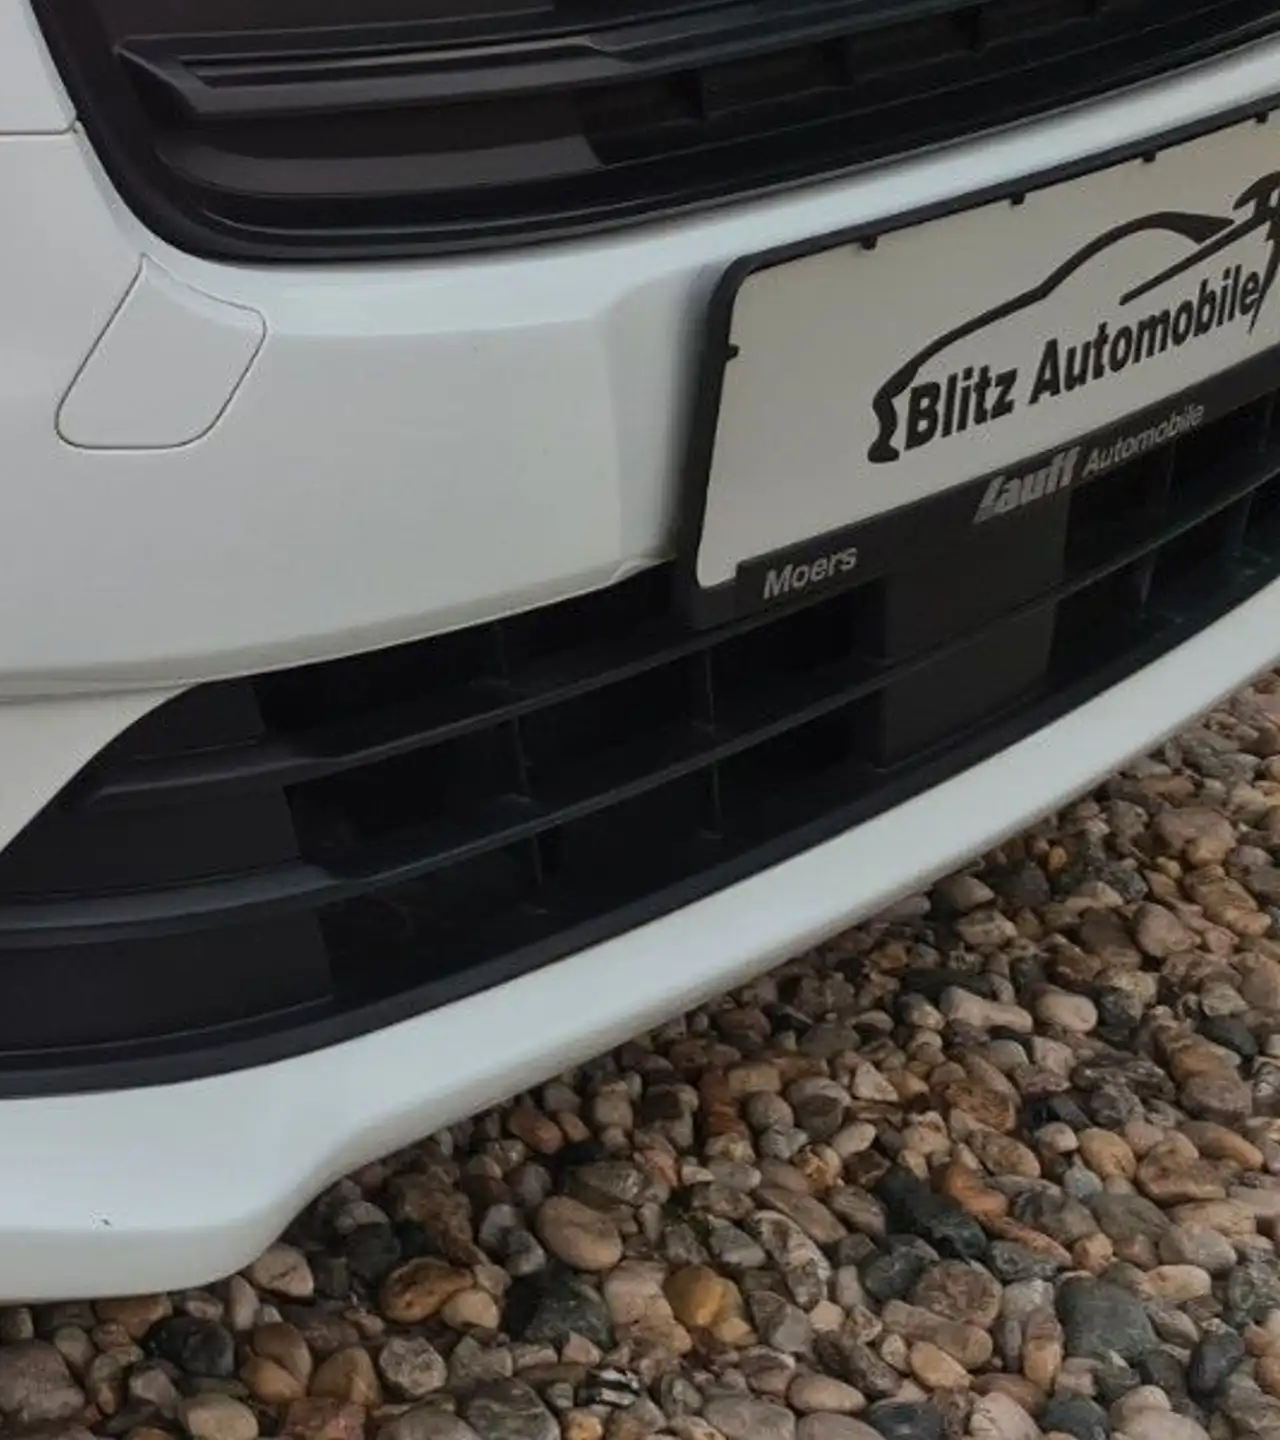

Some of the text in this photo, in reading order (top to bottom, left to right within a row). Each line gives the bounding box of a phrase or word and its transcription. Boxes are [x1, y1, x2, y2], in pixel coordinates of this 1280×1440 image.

[905, 264, 1262, 450] Blitz Automobile
[1083, 404, 1205, 478] Automobile
[763, 547, 858, 599] Moers
